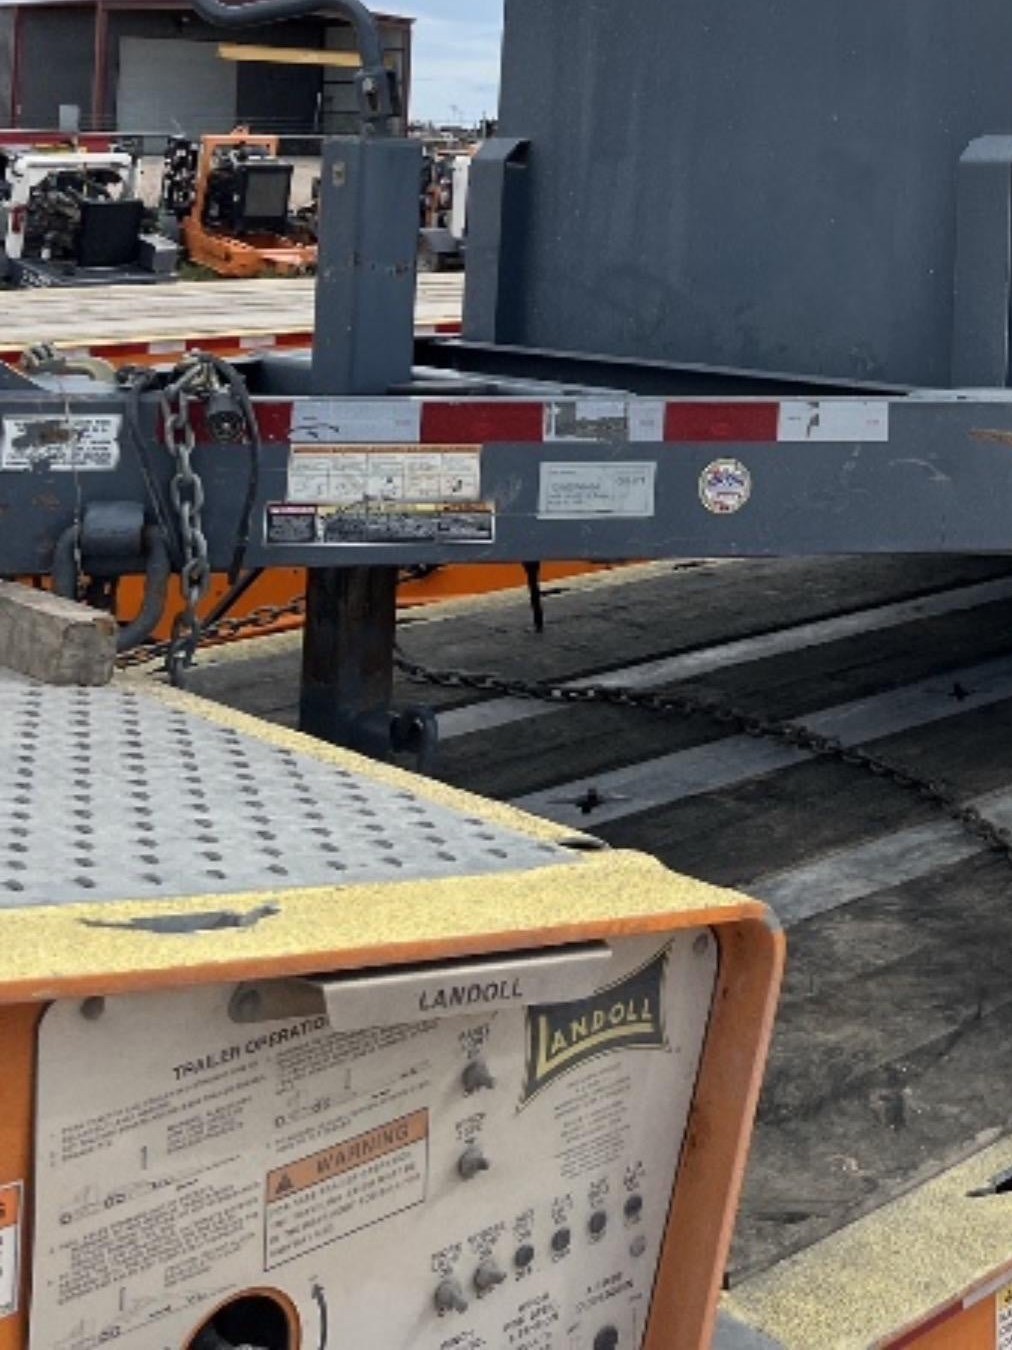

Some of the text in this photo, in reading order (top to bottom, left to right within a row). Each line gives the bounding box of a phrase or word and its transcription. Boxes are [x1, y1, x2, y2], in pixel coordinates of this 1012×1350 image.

[419, 978, 523, 1011] LANDOLL
[172, 1044, 241, 1080] TRAILER
[244, 1016, 330, 1054] OPERATIO
[535, 998, 654, 1079] LANDOLL
